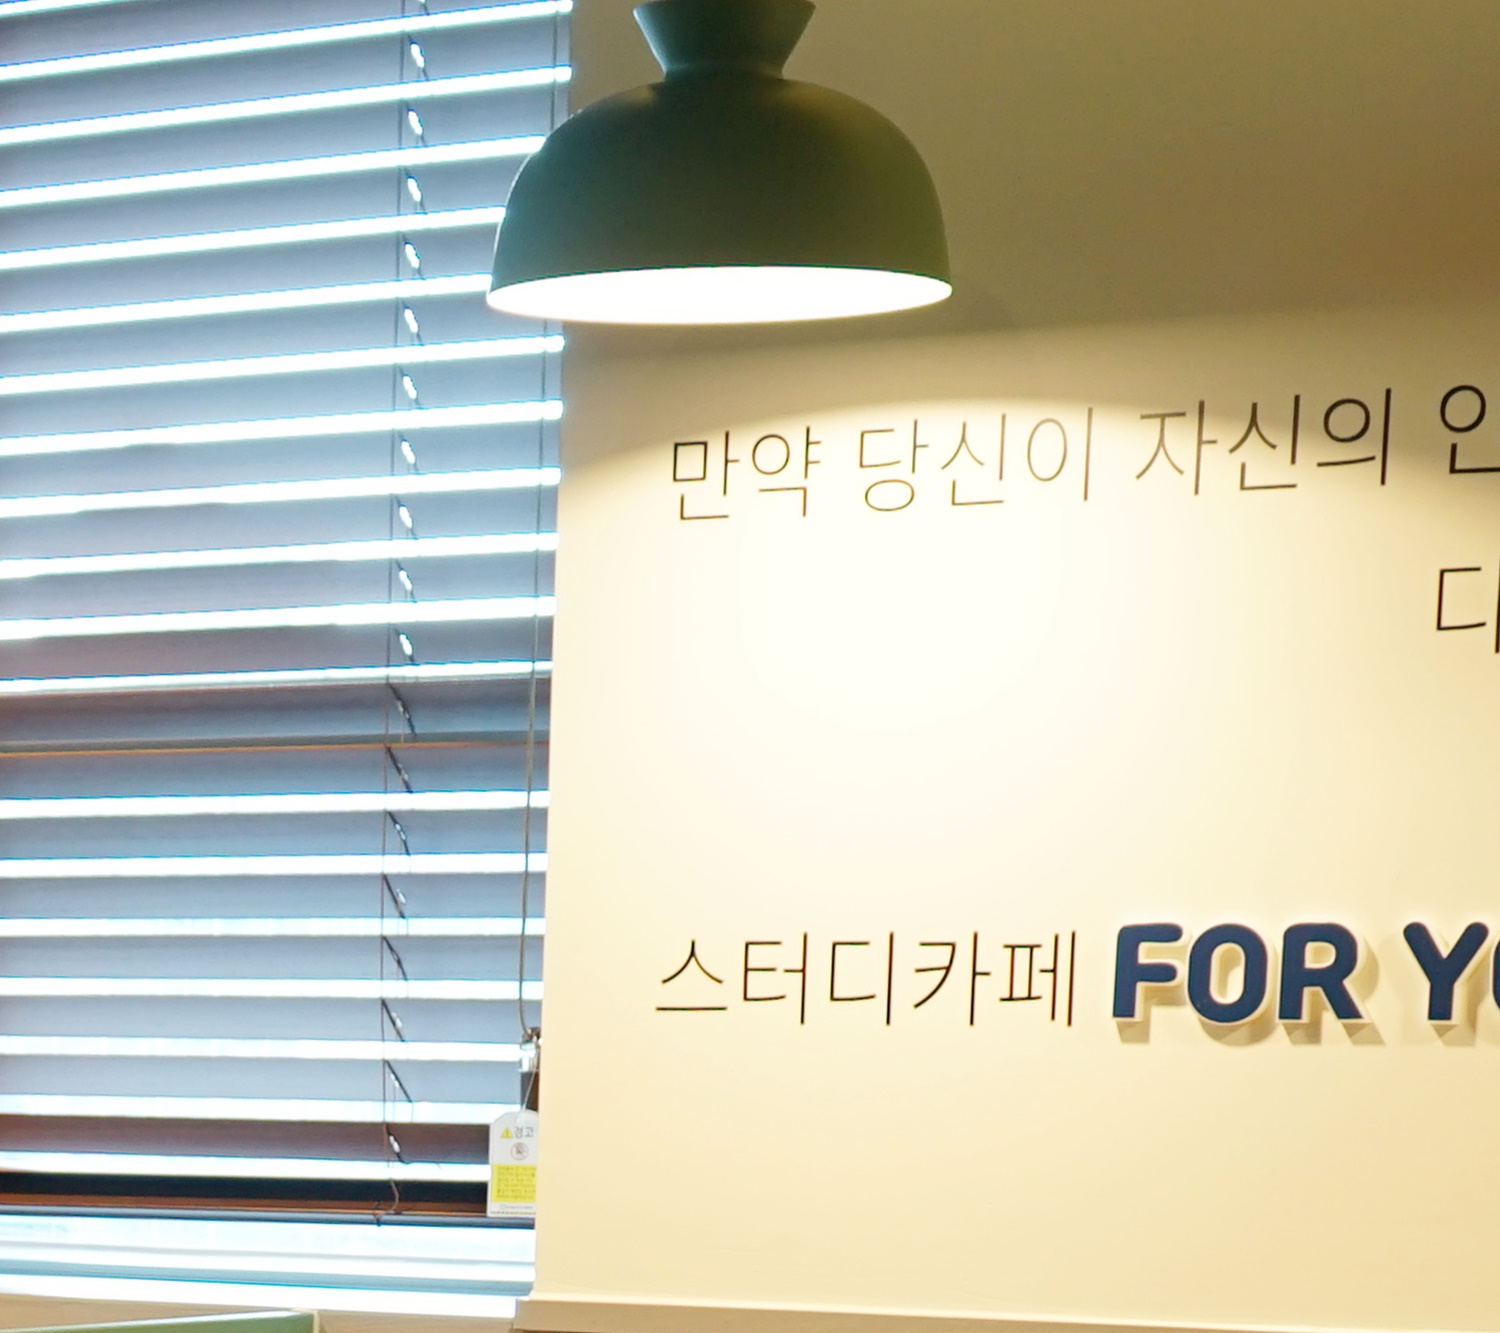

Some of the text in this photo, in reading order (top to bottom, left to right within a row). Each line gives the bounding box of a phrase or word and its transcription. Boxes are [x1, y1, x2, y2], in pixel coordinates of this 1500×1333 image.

[672, 426, 822, 521] 만약
[858, 407, 1094, 512] 당신이
[1134, 386, 1394, 497] 자신의
[654, 929, 1078, 1029] 스터디카페
[1112, 922, 1363, 1024] FOR
